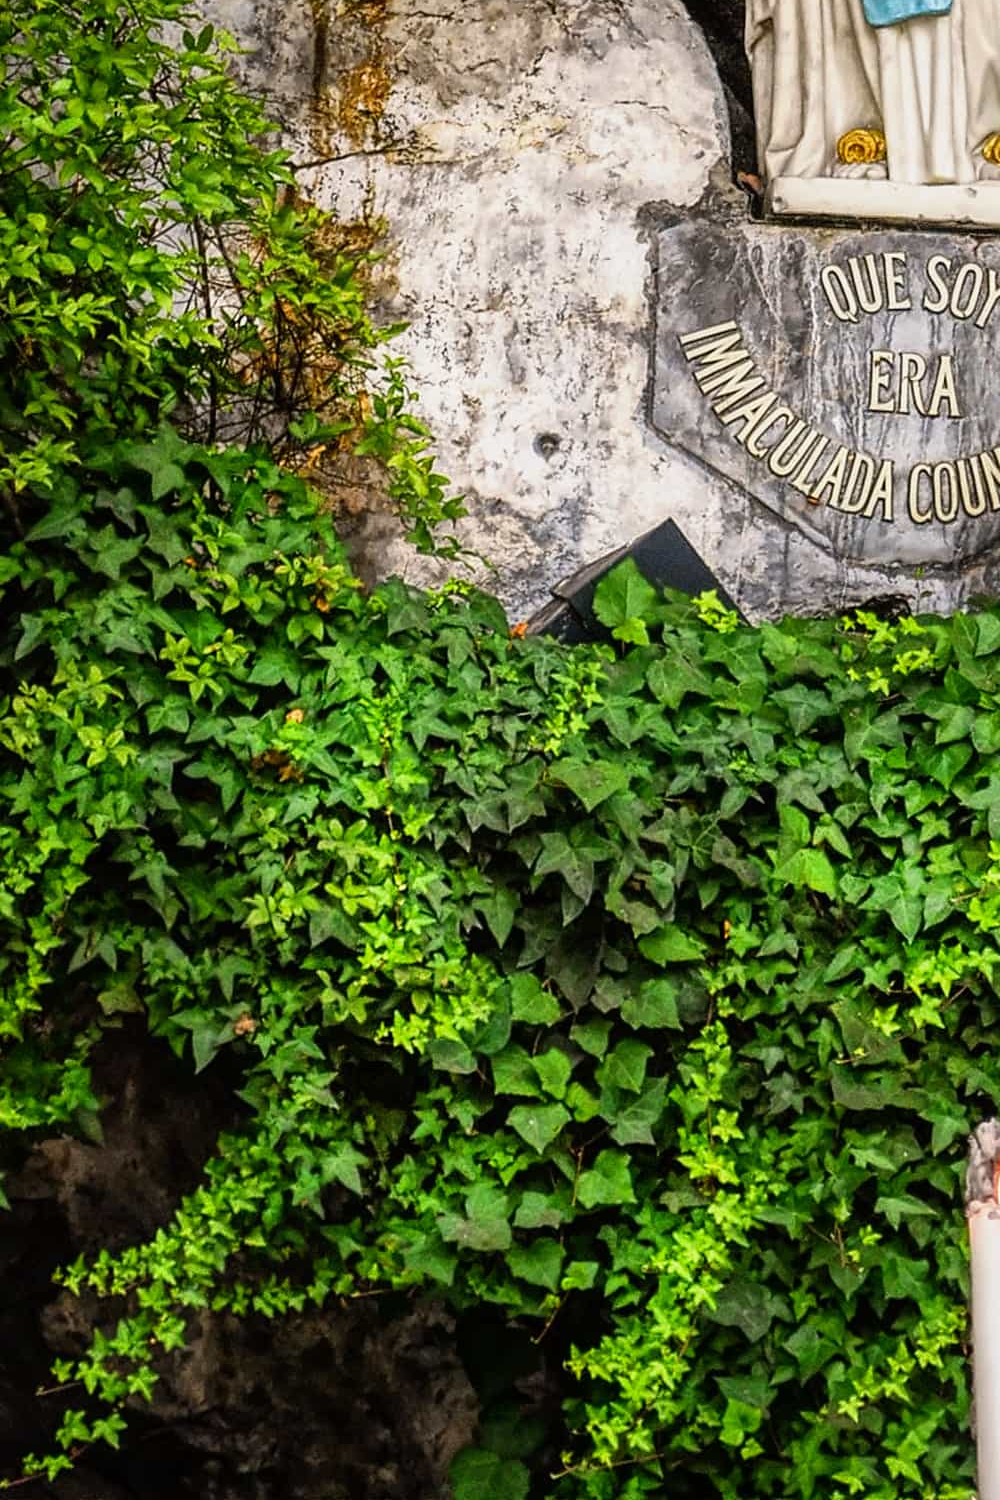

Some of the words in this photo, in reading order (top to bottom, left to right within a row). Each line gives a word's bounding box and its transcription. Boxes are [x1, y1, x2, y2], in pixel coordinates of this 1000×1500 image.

[820, 252, 912, 324] QUE
[868, 350, 963, 418] ERA
[678, 319, 894, 522] IMMACULADA
